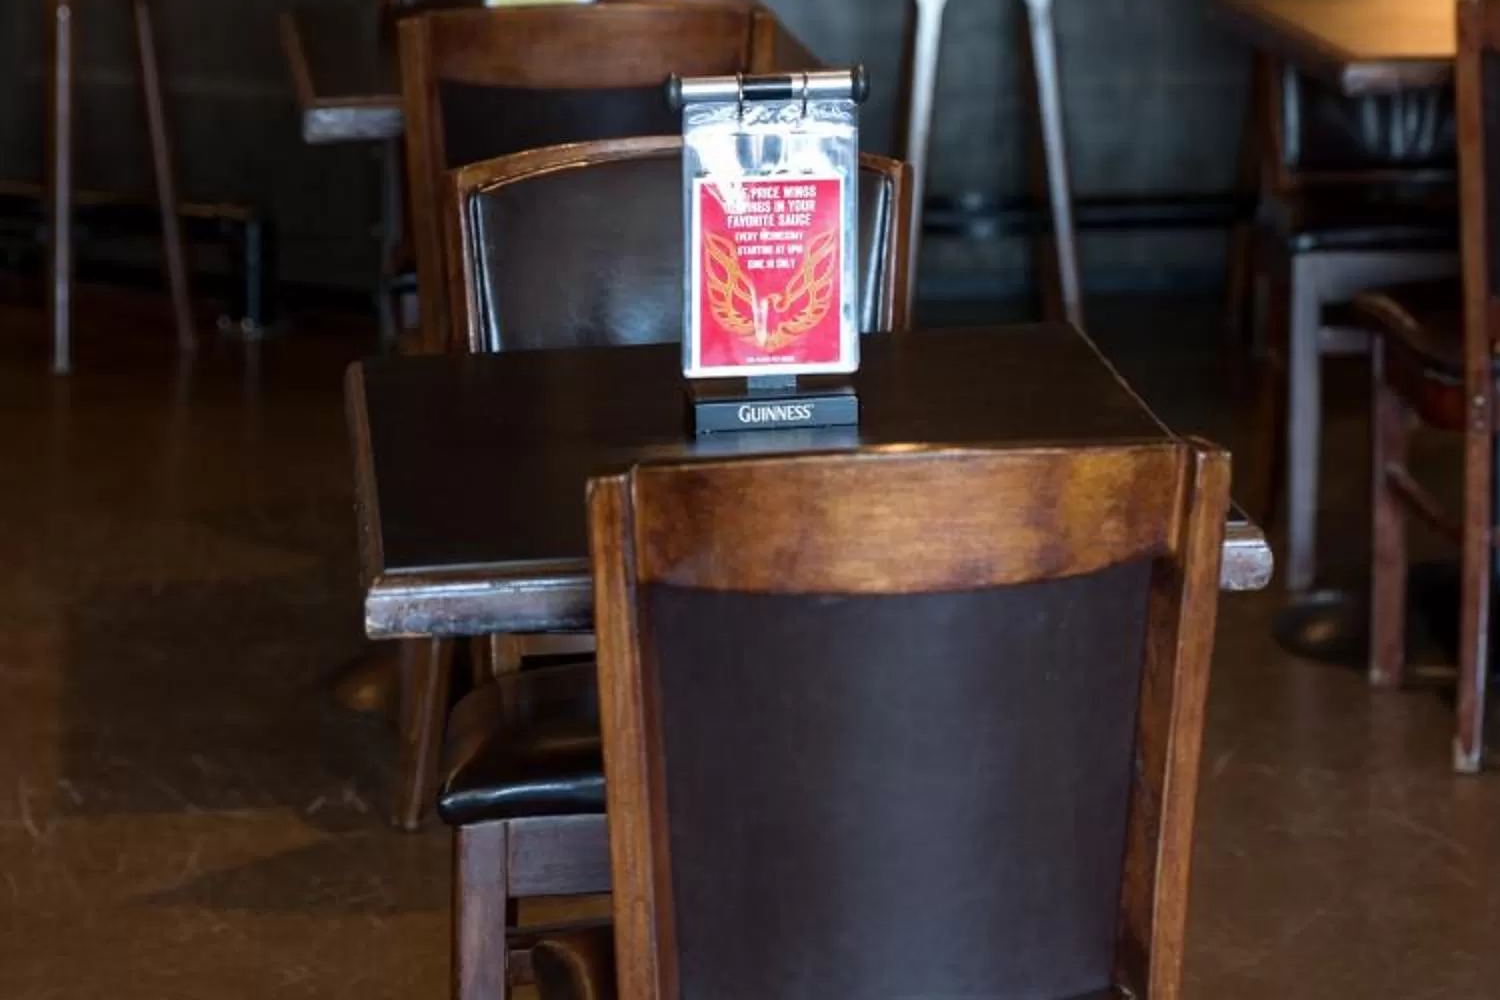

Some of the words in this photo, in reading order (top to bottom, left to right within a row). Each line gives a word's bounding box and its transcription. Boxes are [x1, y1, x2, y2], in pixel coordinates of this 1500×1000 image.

[788, 199, 816, 212] YOUR
[727, 214, 775, 228] FAVORITE
[778, 213, 812, 227] SAUCE
[737, 404, 812, 423] GUINNESS
